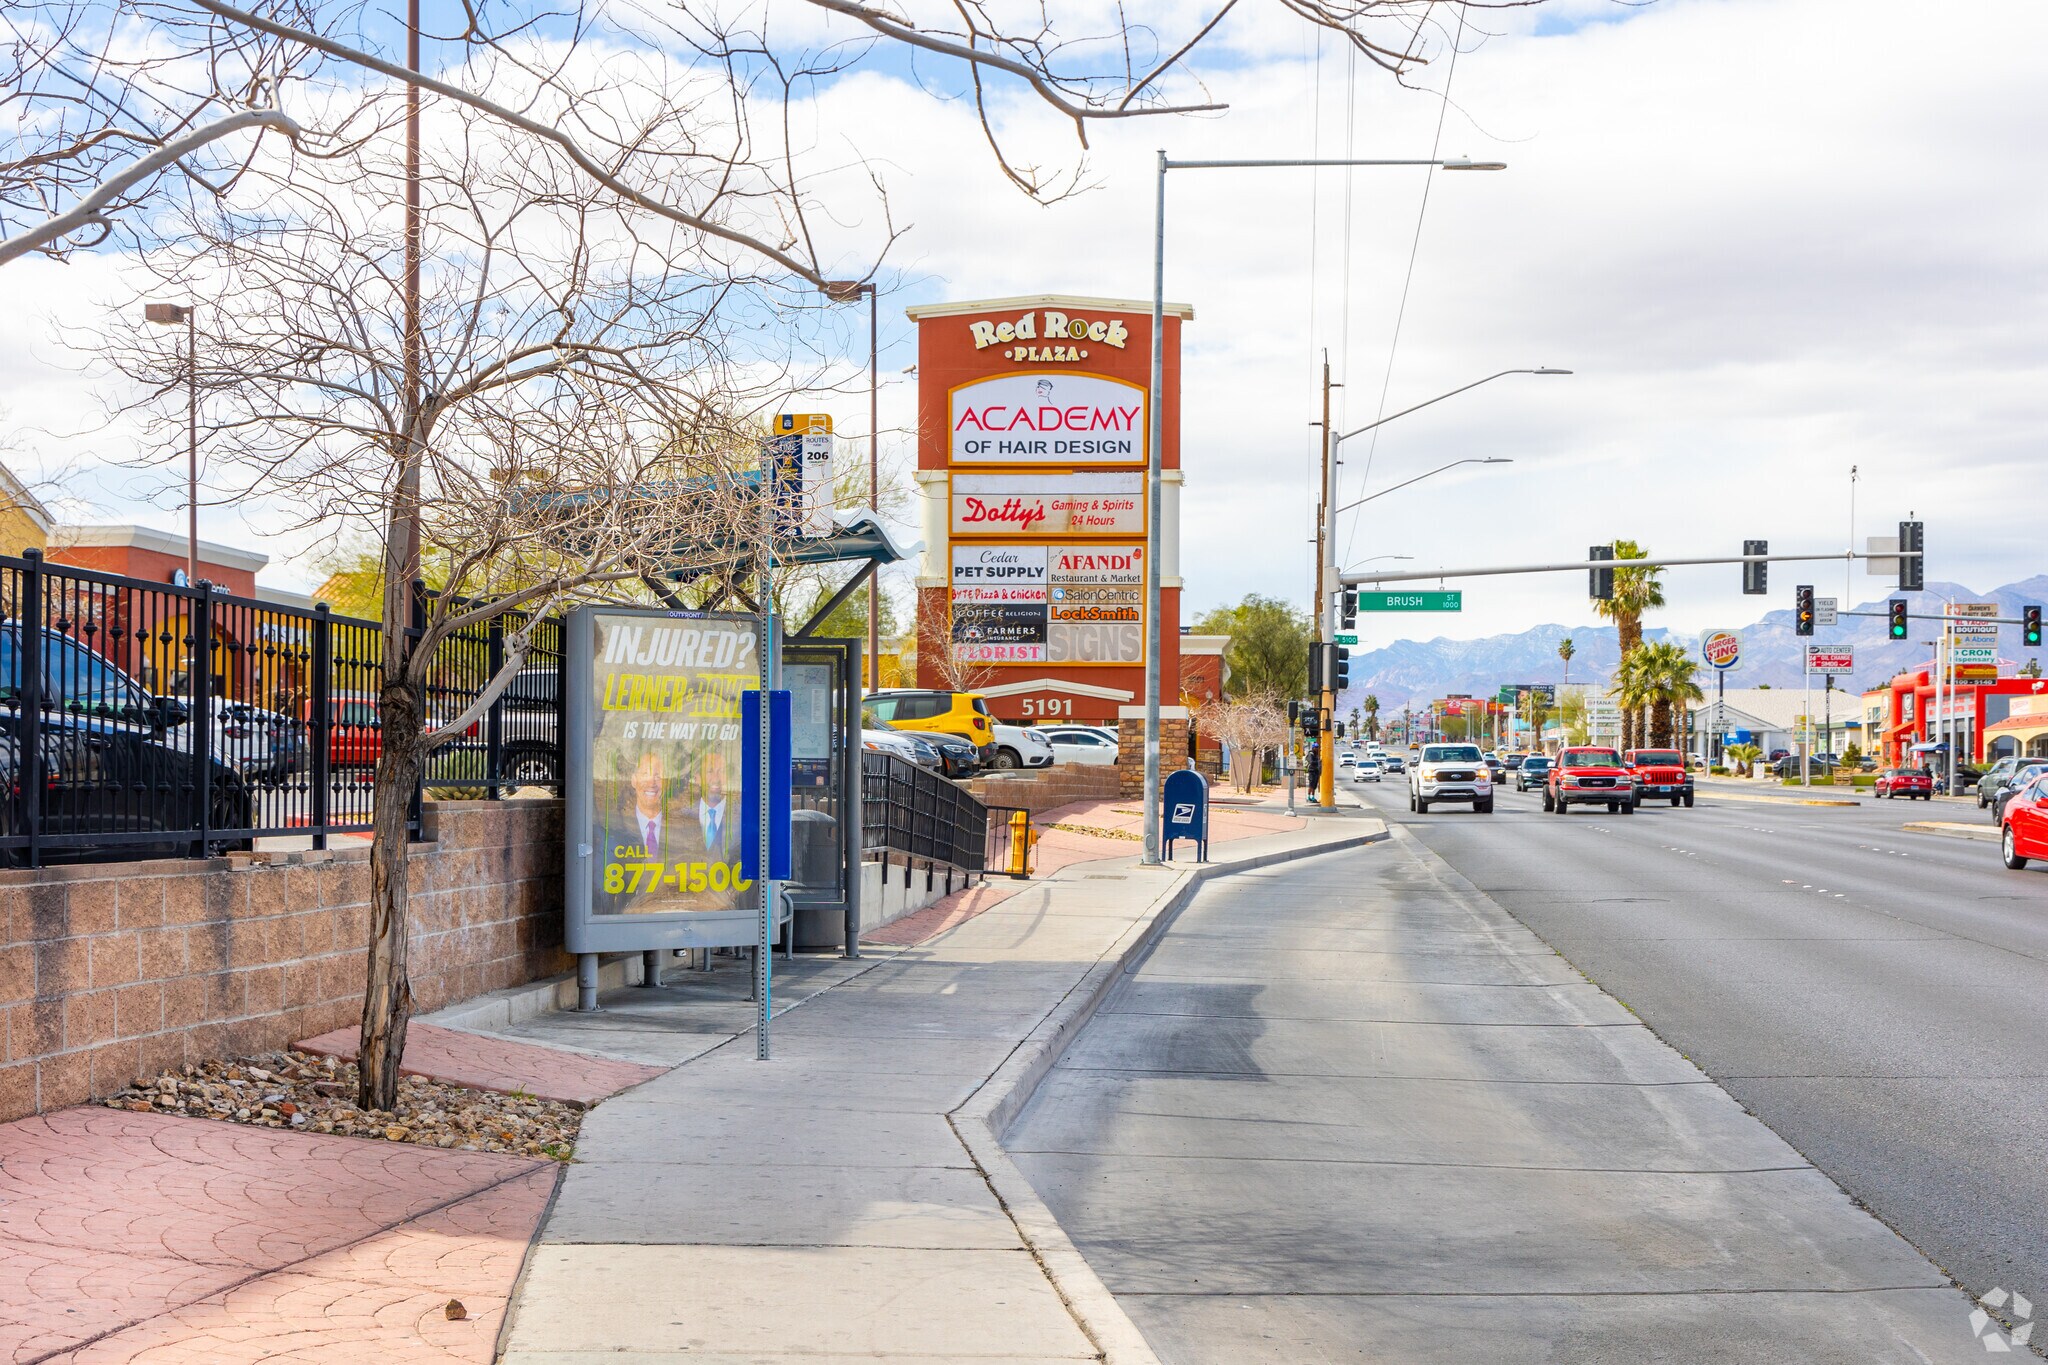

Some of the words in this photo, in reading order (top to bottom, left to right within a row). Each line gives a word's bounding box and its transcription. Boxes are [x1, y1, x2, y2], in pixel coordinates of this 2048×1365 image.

[970, 312, 1036, 350] Red
[1045, 312, 1128, 349] Rock
[1014, 346, 1080, 362] PLAZA
[955, 406, 1140, 431] ACADEMY
[964, 440, 991, 454] OF
[999, 441, 1047, 454] HAIR
[1055, 440, 1131, 454] DESIGN
[807, 452, 828, 460] 206
[962, 497, 1045, 530] Dotty's
[1052, 500, 1088, 512] Gaming
[1092, 500, 1098, 510] &
[1102, 500, 1134, 512] Spirits
[1072, 516, 1084, 525] 24
[1087, 516, 1115, 526] Hours
[980, 550, 1019, 564] Cedar
[1058, 555, 1131, 570] AFANDI
[955, 567, 983, 577] PET
[986, 567, 1044, 577] SUPPLY
[1052, 574, 1098, 583] Restaurant
[1111, 574, 1140, 582] Market
[975, 588, 999, 599] Pizza
[1002, 588, 1008, 600] &
[1065, 589, 1138, 600] SalonCentric
[1387, 597, 1423, 606] BRUSH
[1051, 606, 1139, 620] LockSmith
[605, 626, 756, 669] INJURED?
[1049, 625, 1140, 661] SIGNS
[1707, 637, 1736, 651] BURGER
[957, 646, 1040, 658] FLORIST
[1708, 645, 1738, 661] KING
[602, 673, 687, 712] LERNER
[686, 688, 694, 702] &
[1022, 699, 1072, 716] 5191
[623, 721, 638, 739] IS
[642, 722, 667, 739] THE
[669, 723, 698, 740] WAY
[701, 724, 718, 740] TO
[720, 724, 739, 740] GO
[614, 846, 652, 858] CALL
